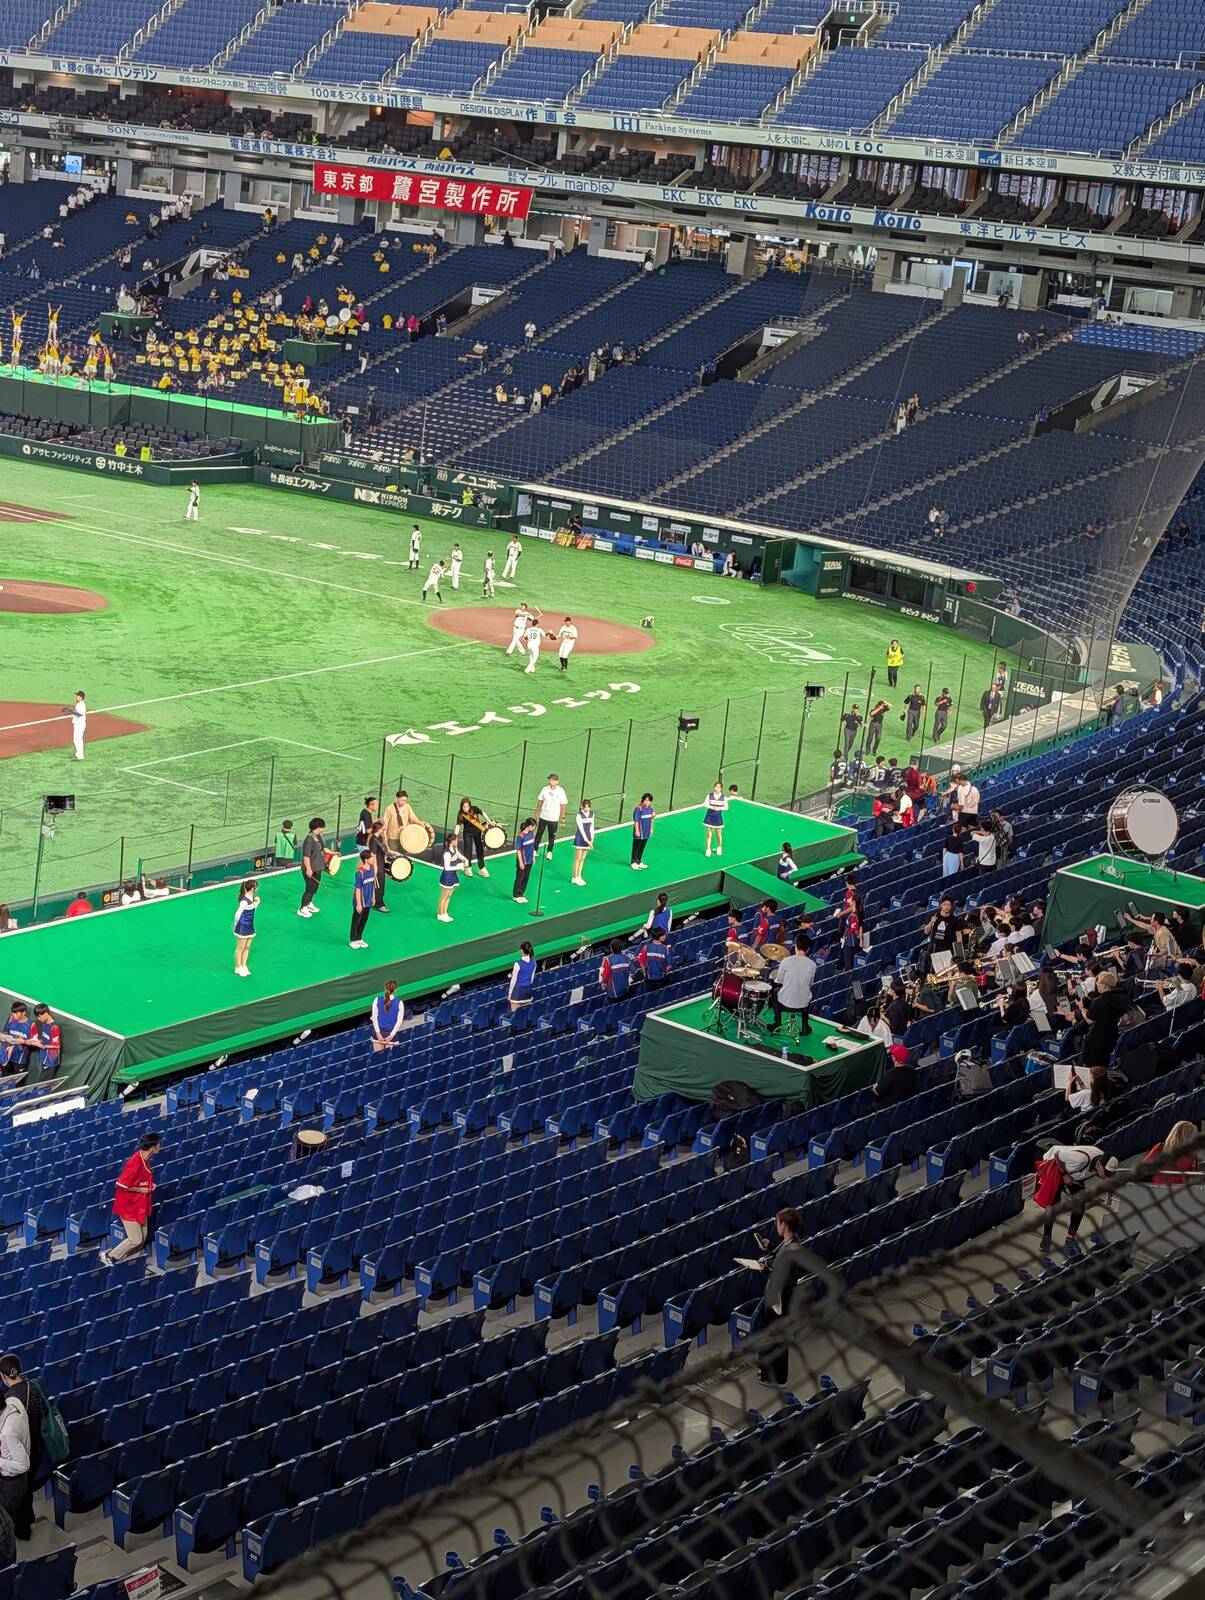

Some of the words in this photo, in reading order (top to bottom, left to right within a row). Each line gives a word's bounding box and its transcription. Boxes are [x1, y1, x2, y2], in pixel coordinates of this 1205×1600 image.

[114, 66, 157, 80] バンテリン
[311, 88, 385, 103] 100年をつくる会社
[460, 103, 487, 114] DESIGN
[488, 106, 493, 114] &
[494, 108, 524, 118] DISPLAY
[107, 125, 138, 136] SONY
[611, 116, 641, 132] IHI
[644, 122, 677, 135] Parking
[678, 124, 712, 136] Systems
[844, 140, 884, 153] LEOC
[1004, 154, 1058, 169] 新日本空調
[518, 173, 558, 187] マーブル
[1112, 164, 1181, 182] 文教大学付属
[323, 170, 374, 193] 東京都
[662, 188, 687, 202] EKC
[698, 192, 722, 206] EKC
[733, 196, 758, 210] EKC
[960, 222, 1087, 248] 東洋ビルサービス
[108, 460, 143, 475] 竹中土木
[277, 474, 331, 492] 長谷工グループ
[380, 499, 408, 510] EXPRESS
[381, 493, 408, 503] NIPPON
[430, 502, 462, 519] 東テク
